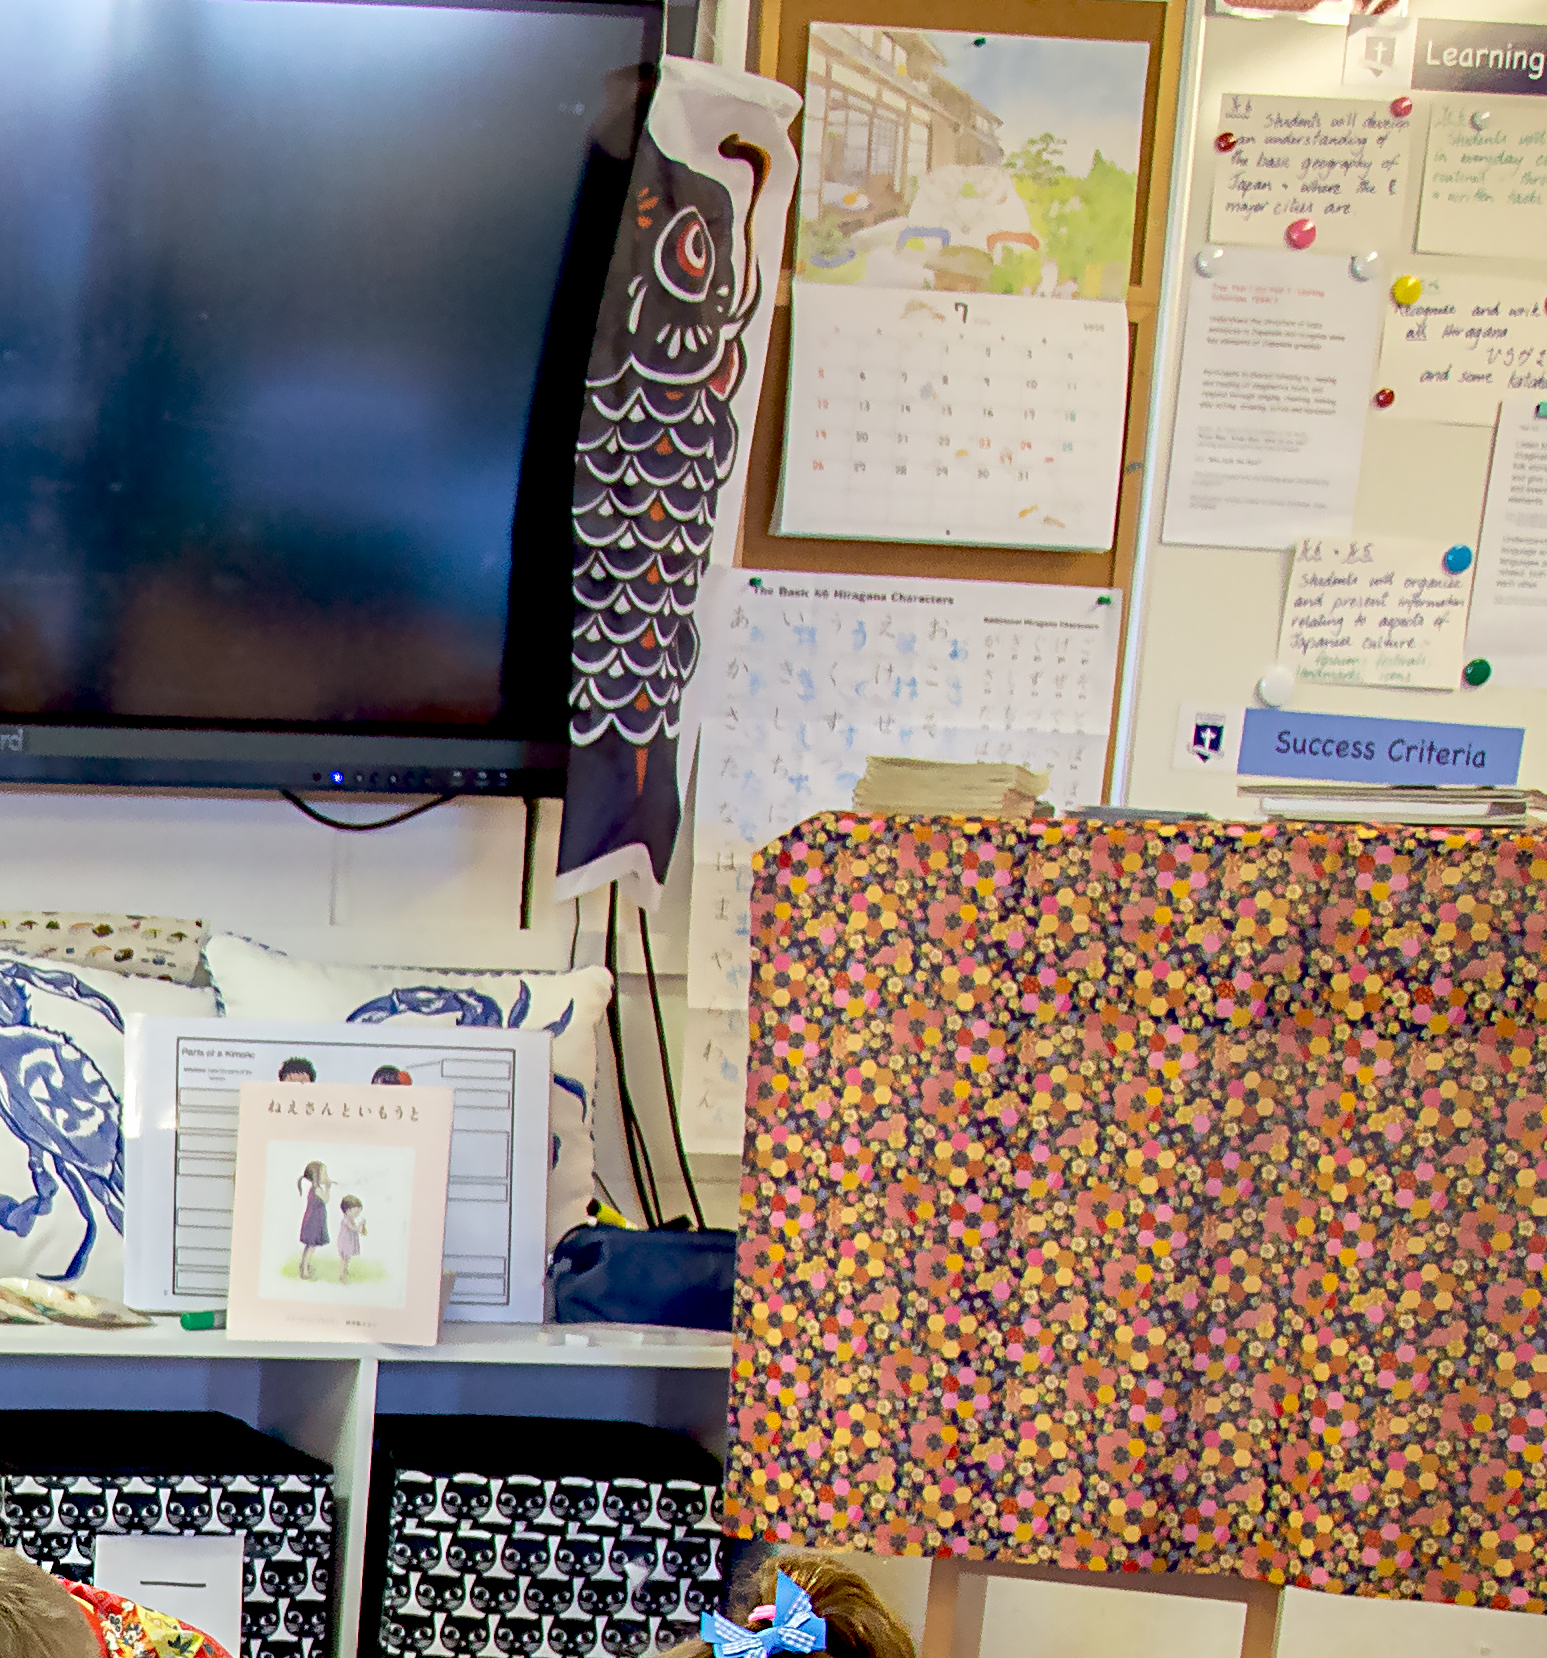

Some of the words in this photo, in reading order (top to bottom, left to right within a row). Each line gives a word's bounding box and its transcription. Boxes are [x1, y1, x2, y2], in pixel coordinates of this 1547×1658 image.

[1426, 39, 1546, 80] Learning
[1275, 730, 1376, 761] Success
[1388, 738, 1487, 769] Criteria
